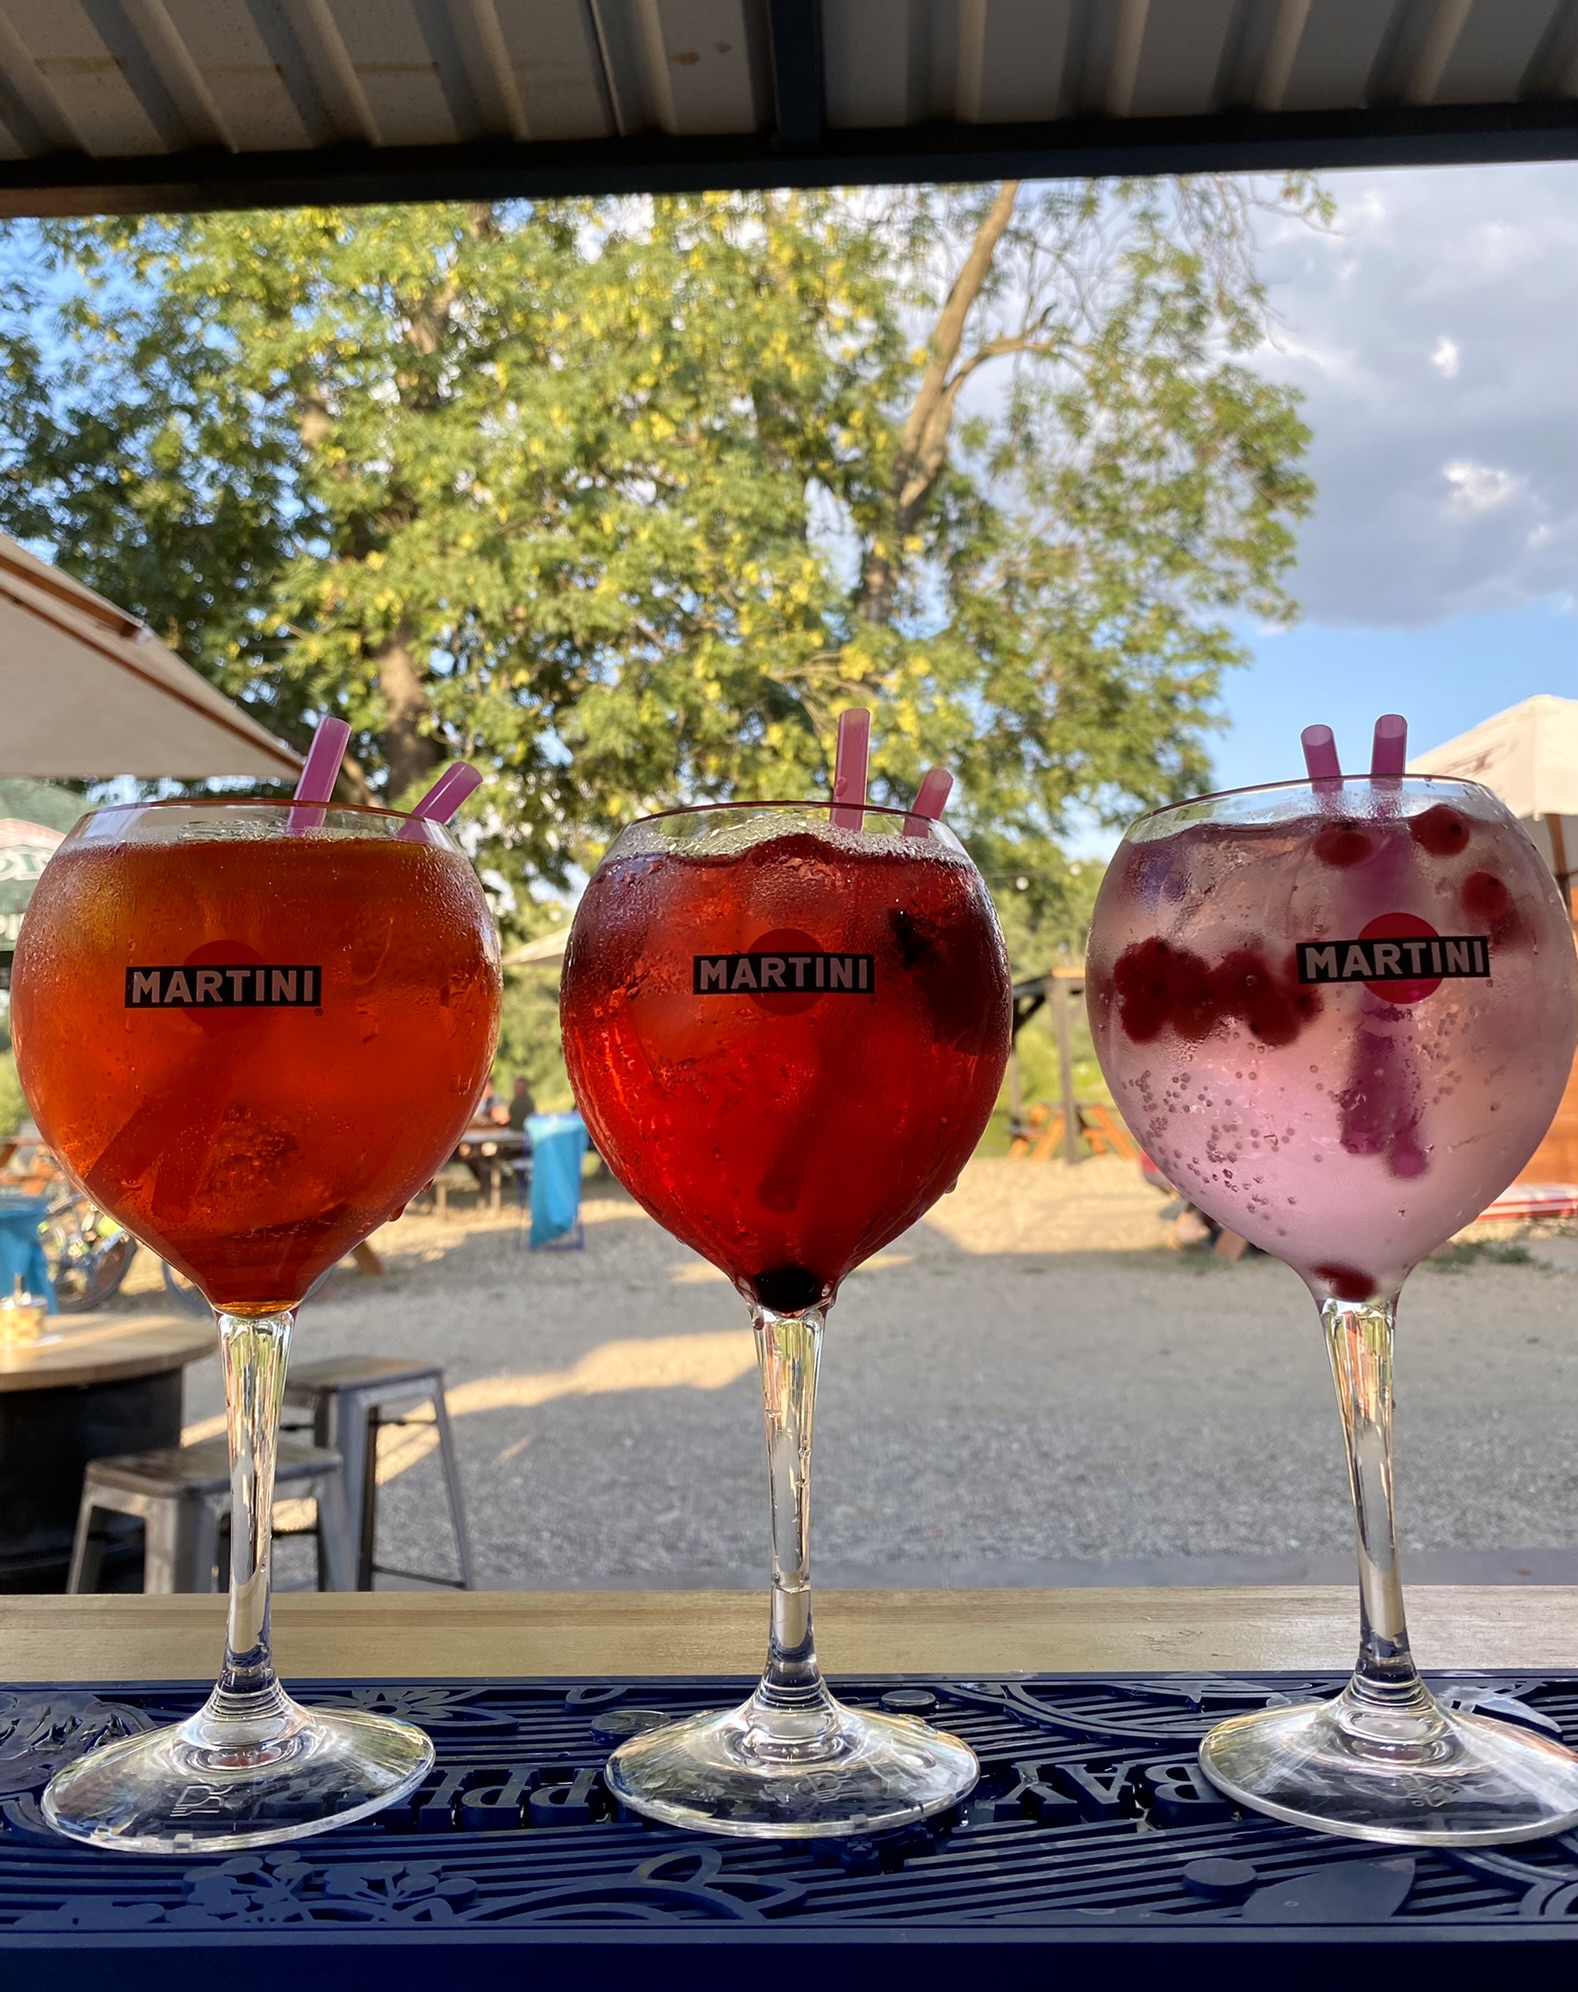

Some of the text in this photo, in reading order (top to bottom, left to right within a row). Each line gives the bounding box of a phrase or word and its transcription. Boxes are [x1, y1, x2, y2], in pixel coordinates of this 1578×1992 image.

[700, 957, 868, 990] MARTINI
[1305, 941, 1484, 979] MARTINI
[132, 970, 314, 1004] MARTINI
